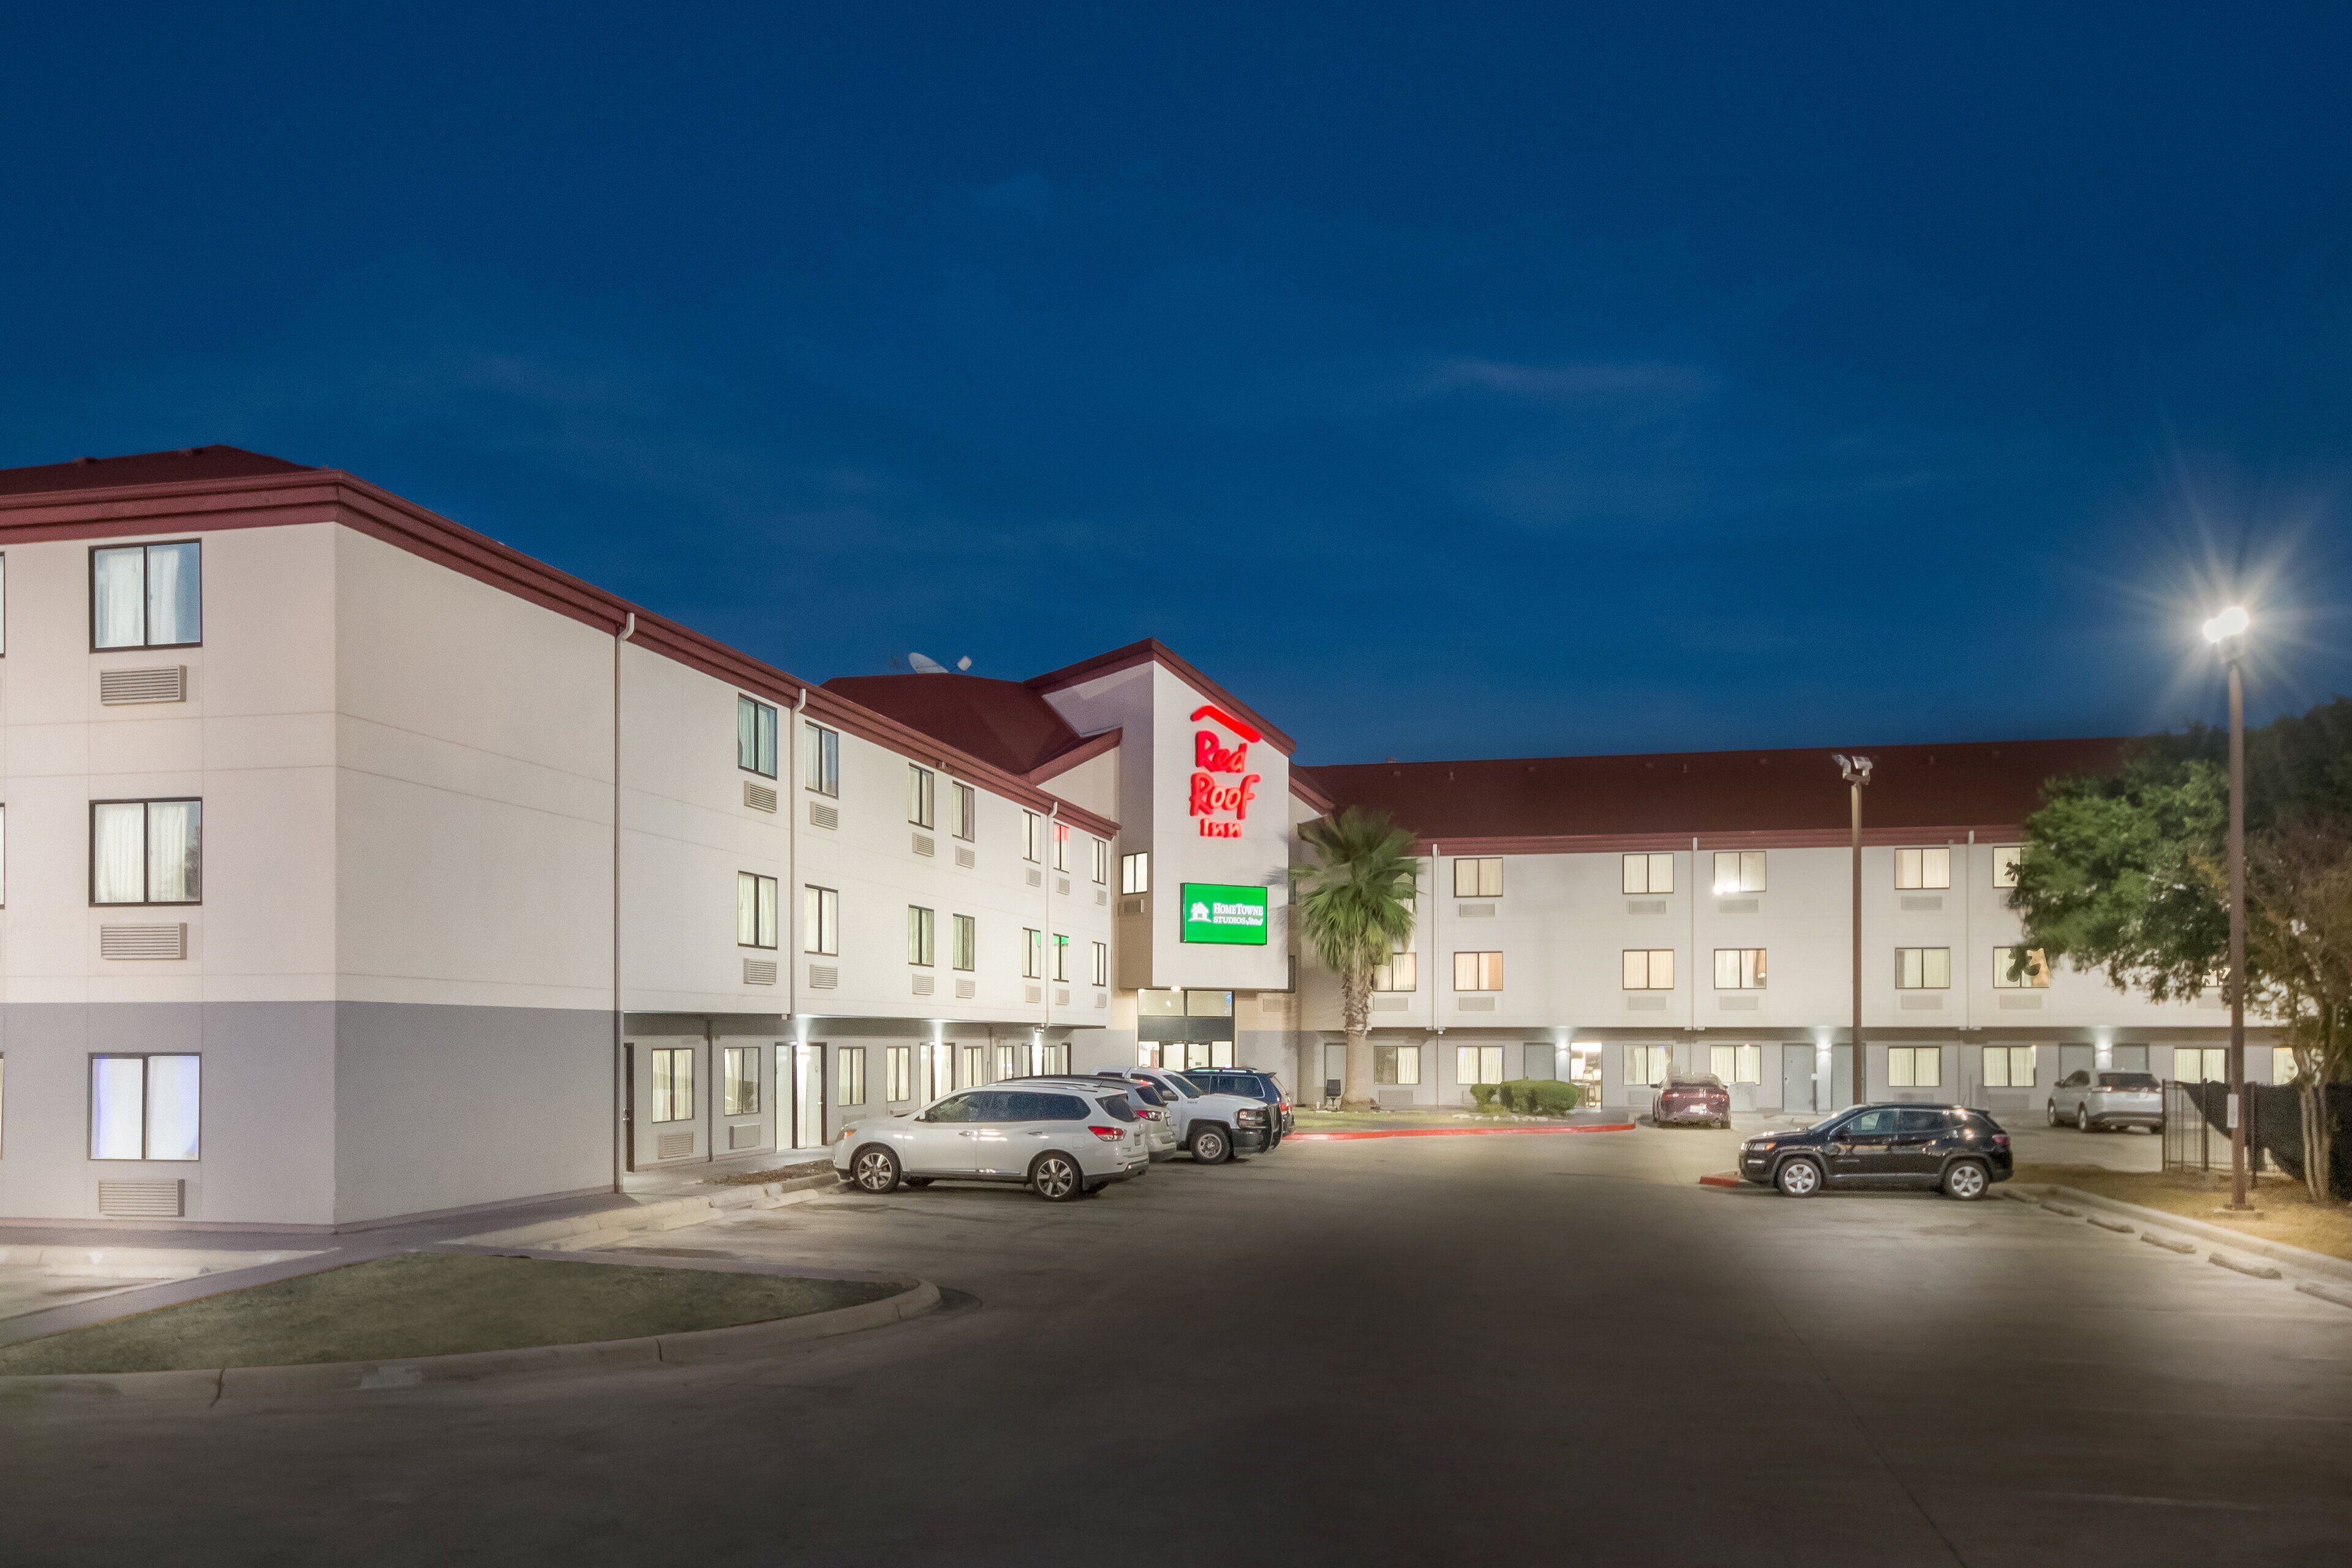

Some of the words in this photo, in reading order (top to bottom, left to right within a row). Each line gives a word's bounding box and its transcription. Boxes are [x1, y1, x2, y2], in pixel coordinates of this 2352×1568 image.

[1196, 730, 1247, 773] Red
[1189, 772, 1261, 820] Roof
[1200, 818, 1242, 837] Inn
